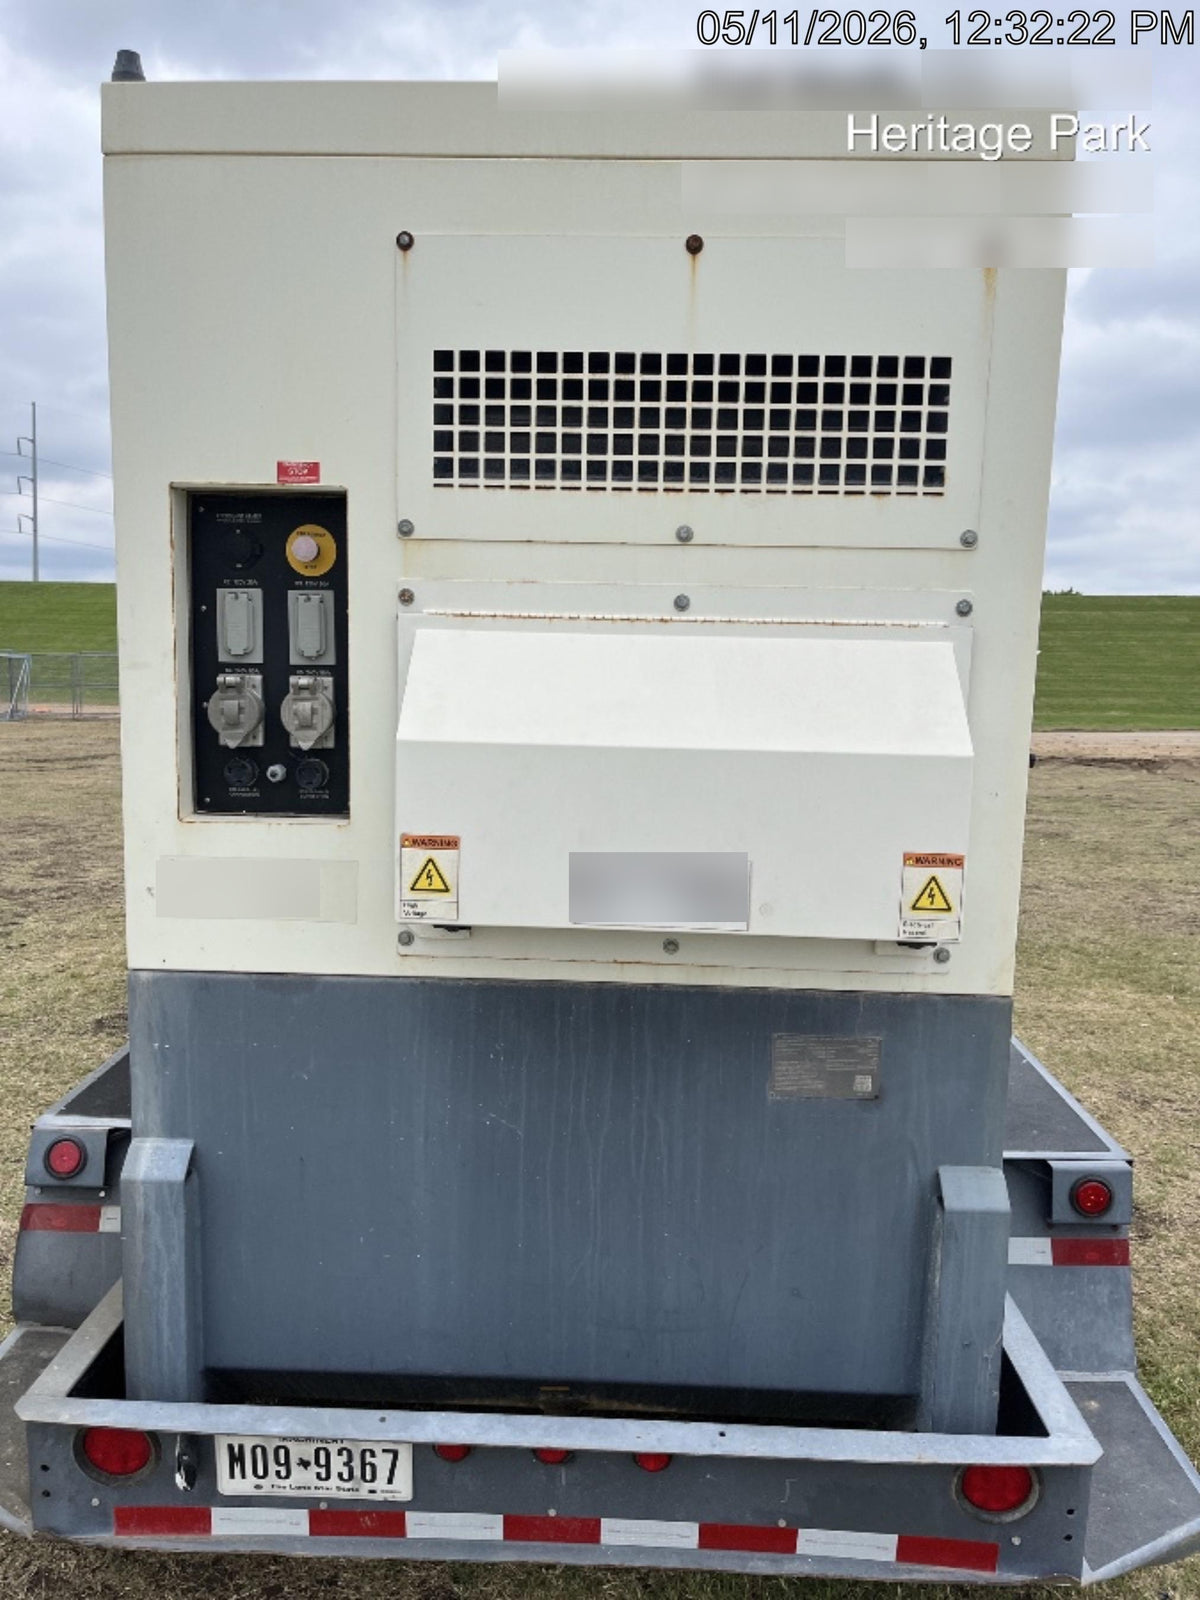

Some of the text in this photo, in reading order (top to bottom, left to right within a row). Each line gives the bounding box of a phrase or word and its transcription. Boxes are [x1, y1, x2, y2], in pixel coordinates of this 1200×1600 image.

[412, 838, 458, 848] WARNING
[915, 856, 963, 867] WARNING
[227, 1443, 399, 1485] M09 9367
